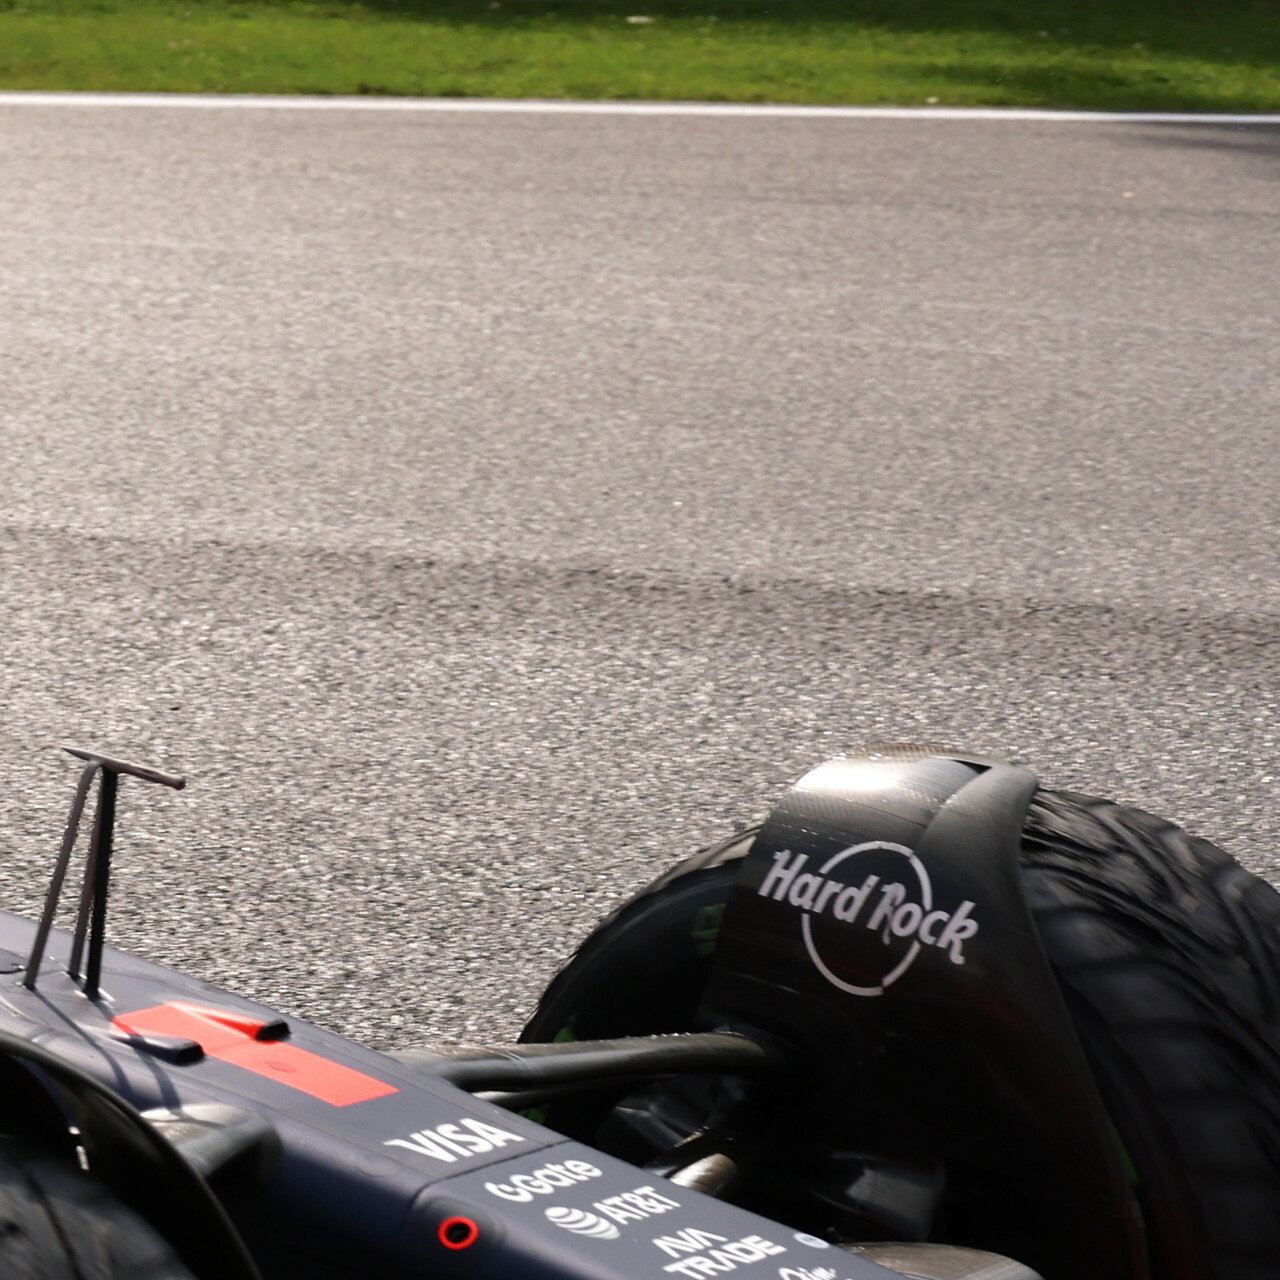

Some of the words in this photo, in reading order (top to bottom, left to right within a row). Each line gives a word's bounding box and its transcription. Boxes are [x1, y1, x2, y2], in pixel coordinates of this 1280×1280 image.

[758, 850, 880, 924] Hard
[866, 881, 979, 965] Rock
[383, 1118, 526, 1163] VISA
[510, 1160, 603, 1195] Gate
[593, 1185, 681, 1225] AT&T
[652, 1228, 728, 1259] AVA
[662, 1235, 787, 1280] TRADE
